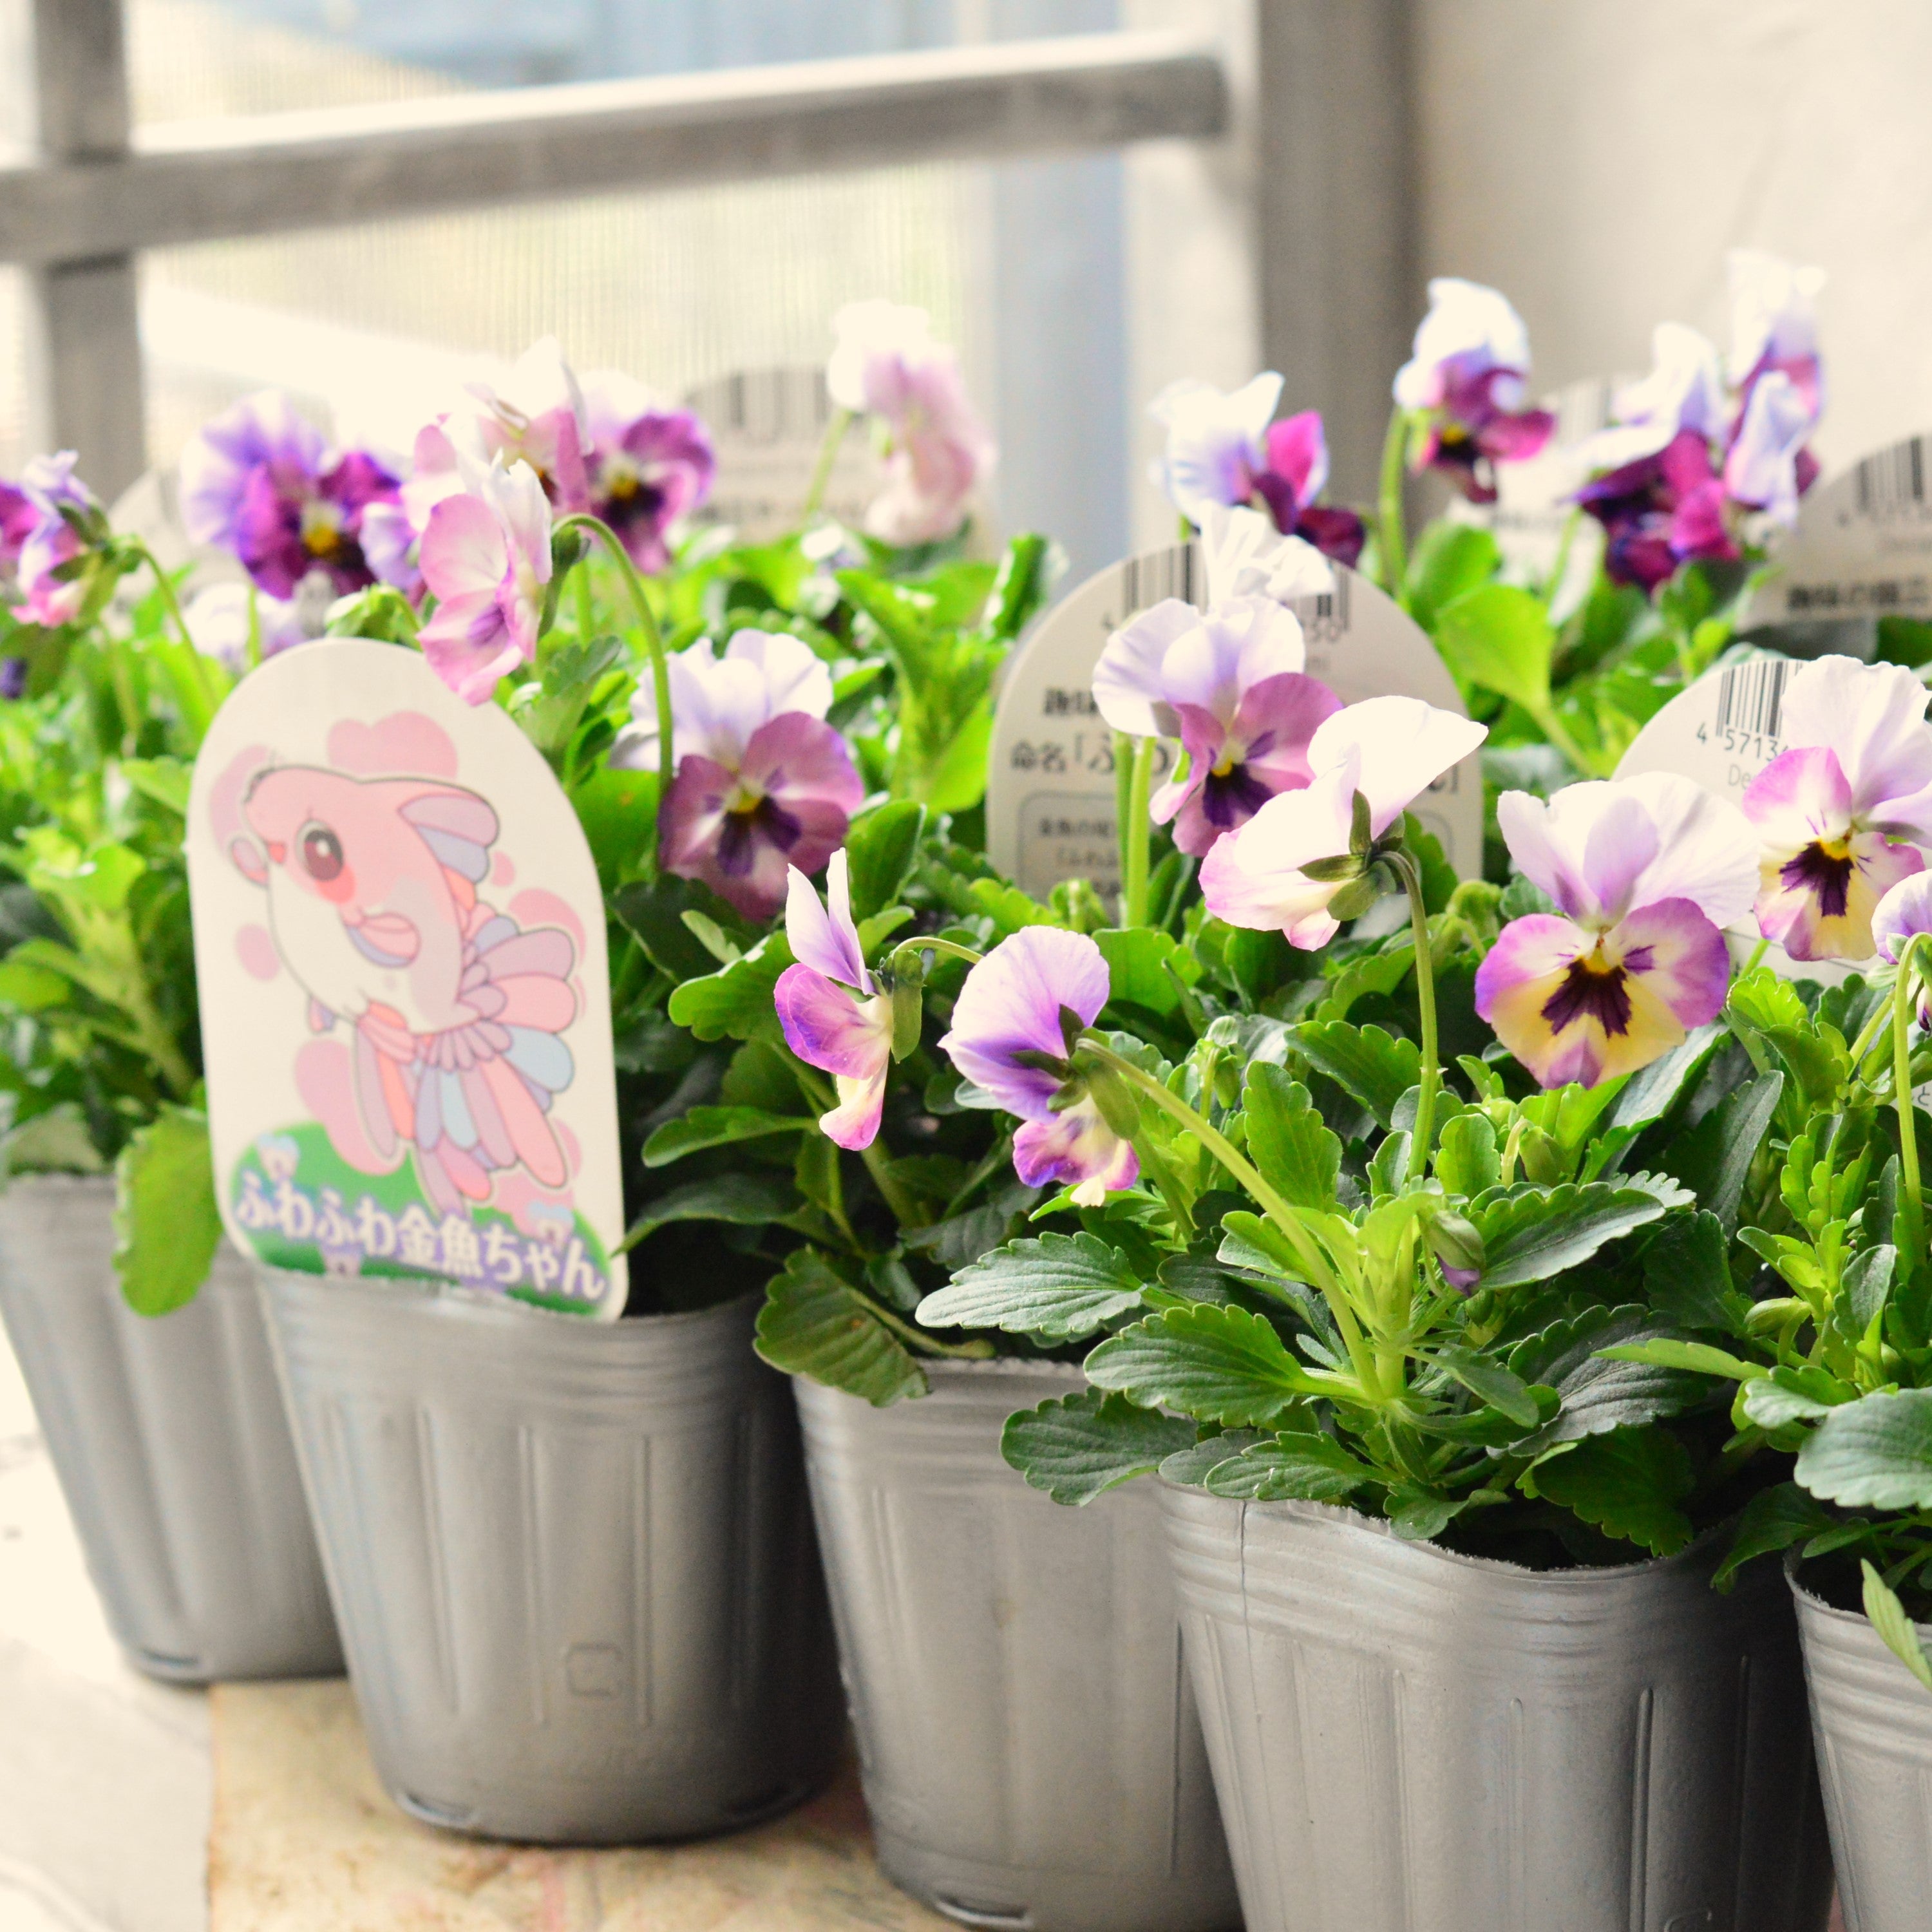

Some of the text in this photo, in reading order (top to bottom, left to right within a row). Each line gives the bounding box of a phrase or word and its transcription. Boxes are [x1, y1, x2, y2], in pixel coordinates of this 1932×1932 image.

[236, 1170, 605, 1299] ふわふわ金魚ちゃん
